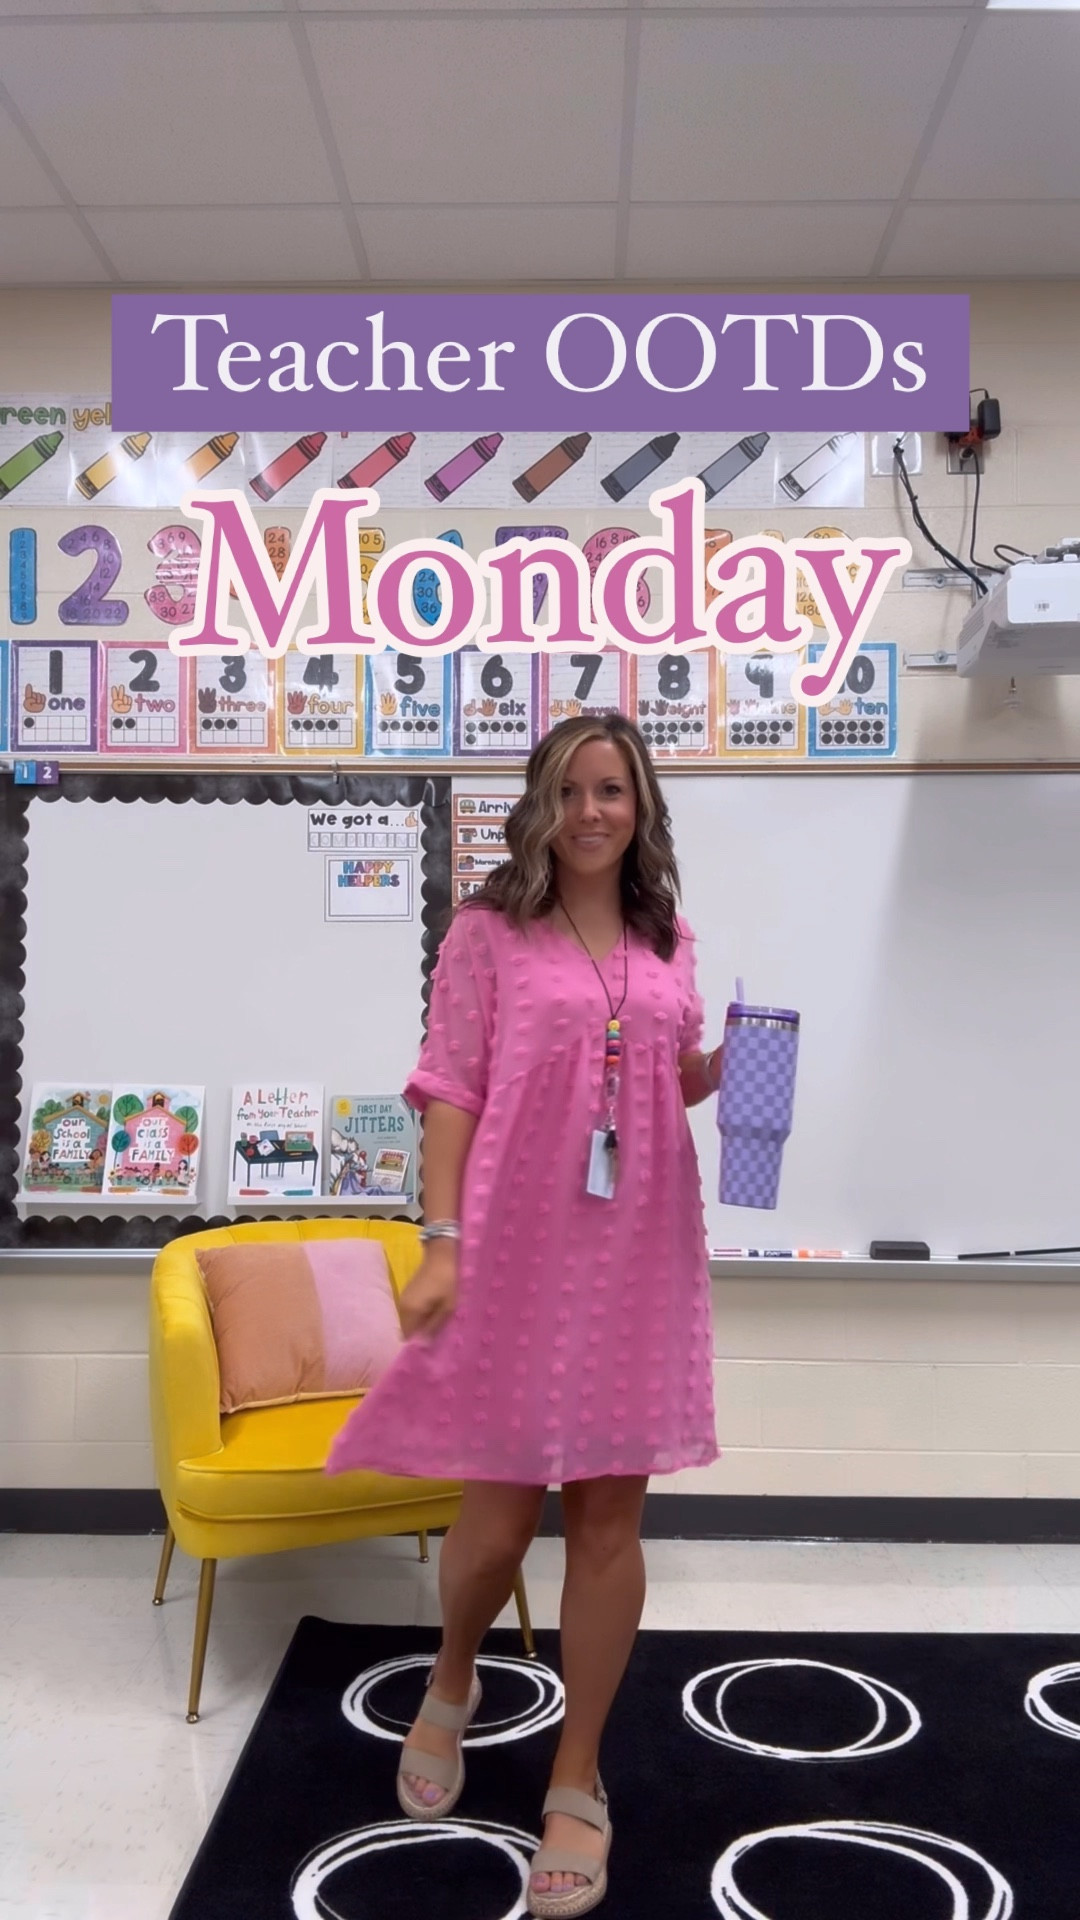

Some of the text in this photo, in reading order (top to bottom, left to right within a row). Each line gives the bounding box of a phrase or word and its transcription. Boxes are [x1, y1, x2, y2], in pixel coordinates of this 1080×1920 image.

[0, 405, 66, 425] reen
[79, 531, 87, 542] 4
[92, 531, 100, 542] 6
[167, 532, 174, 542] 6
[178, 531, 186, 542] 9
[268, 533, 285, 544] 24
[373, 533, 381, 545] 5
[595, 537, 607, 548] 16
[610, 532, 619, 545] 8
[103, 553, 114, 564] 10
[268, 547, 285, 558] 28
[586, 552, 602, 562] 24
[99, 567, 111, 579] 12
[418, 572, 435, 583] 24
[89, 581, 100, 591] 14
[417, 587, 433, 598] 30
[149, 591, 166, 603] 33
[83, 608, 100, 619] 20
[104, 608, 121, 618] 22
[160, 606, 177, 617] 30
[421, 602, 437, 614] 36
[49, 650, 63, 695] 1
[129, 649, 160, 692] 2
[218, 655, 247, 693] 3
[303, 654, 339, 692] 4
[394, 653, 426, 695] 5
[480, 654, 513, 698] 6
[570, 654, 603, 700] 7
[657, 654, 691, 700] 8
[48, 697, 86, 711] one
[134, 693, 176, 713] two
[218, 695, 266, 713] three
[308, 693, 354, 715] four
[399, 695, 441, 717] five
[498, 699, 526, 716] six
[855, 696, 888, 715] ten
[43, 766, 52, 779] 2
[310, 813, 337, 826] We
[342, 813, 373, 829] got
[342, 860, 395, 874] HAPPY
[337, 874, 400, 887] HELPERS
[243, 1087, 308, 1105] A Letter
[237, 1107, 256, 1120] from
[279, 1105, 319, 1118] Teacher
[357, 1104, 393, 1114] FIRST DAY
[344, 1116, 405, 1134] JITTERS
[52, 1149, 89, 1160] FAMILY
[131, 1149, 173, 1161] FAMILY
